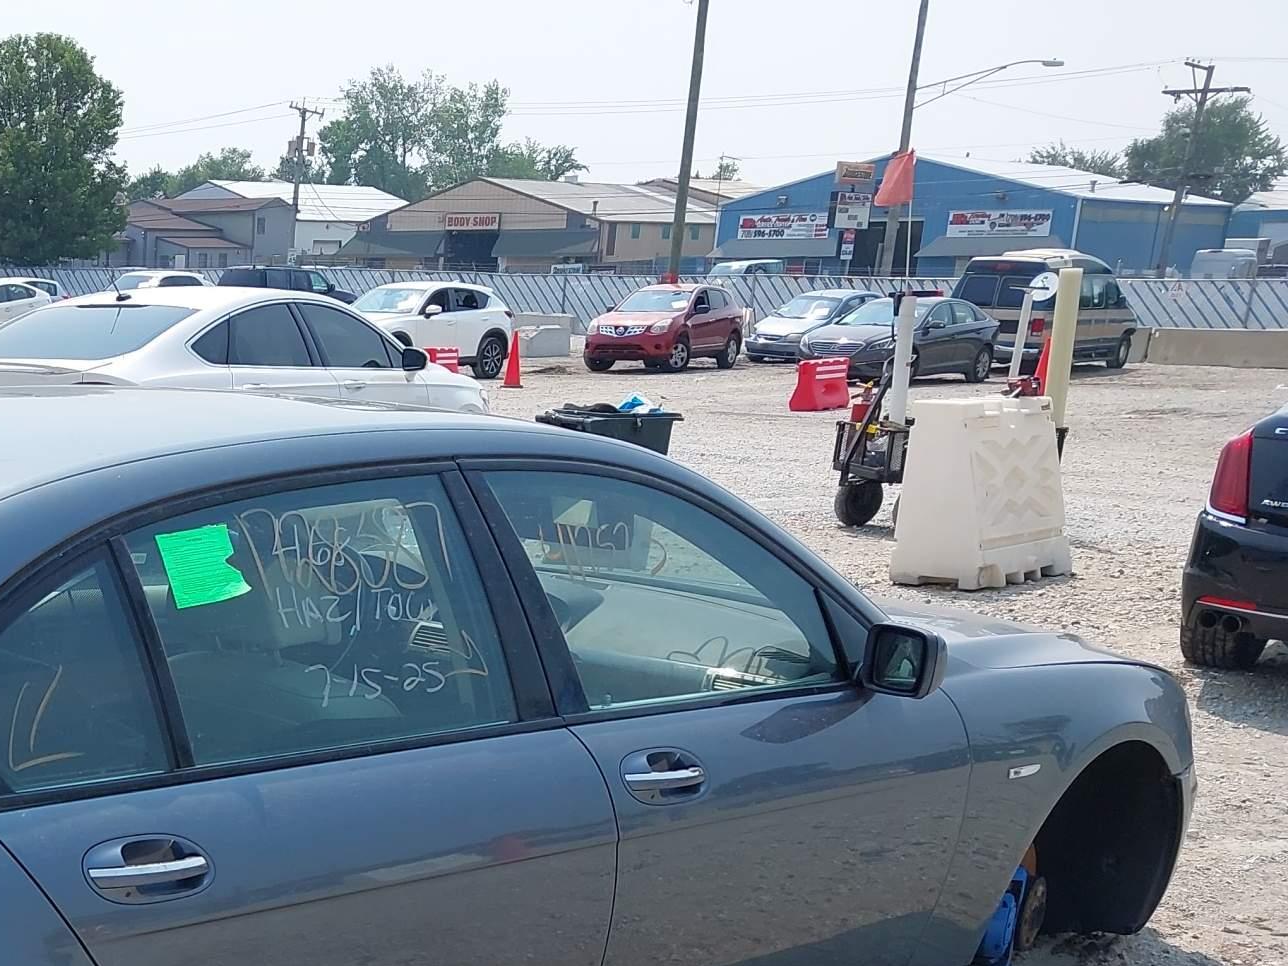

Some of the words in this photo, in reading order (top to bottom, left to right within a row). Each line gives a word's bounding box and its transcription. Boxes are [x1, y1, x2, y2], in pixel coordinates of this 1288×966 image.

[447, 216, 471, 227] BODY
[472, 216, 497, 227] SHOP
[753, 229, 785, 238] 596-5700
[304, 661, 446, 708] 7-15-25
